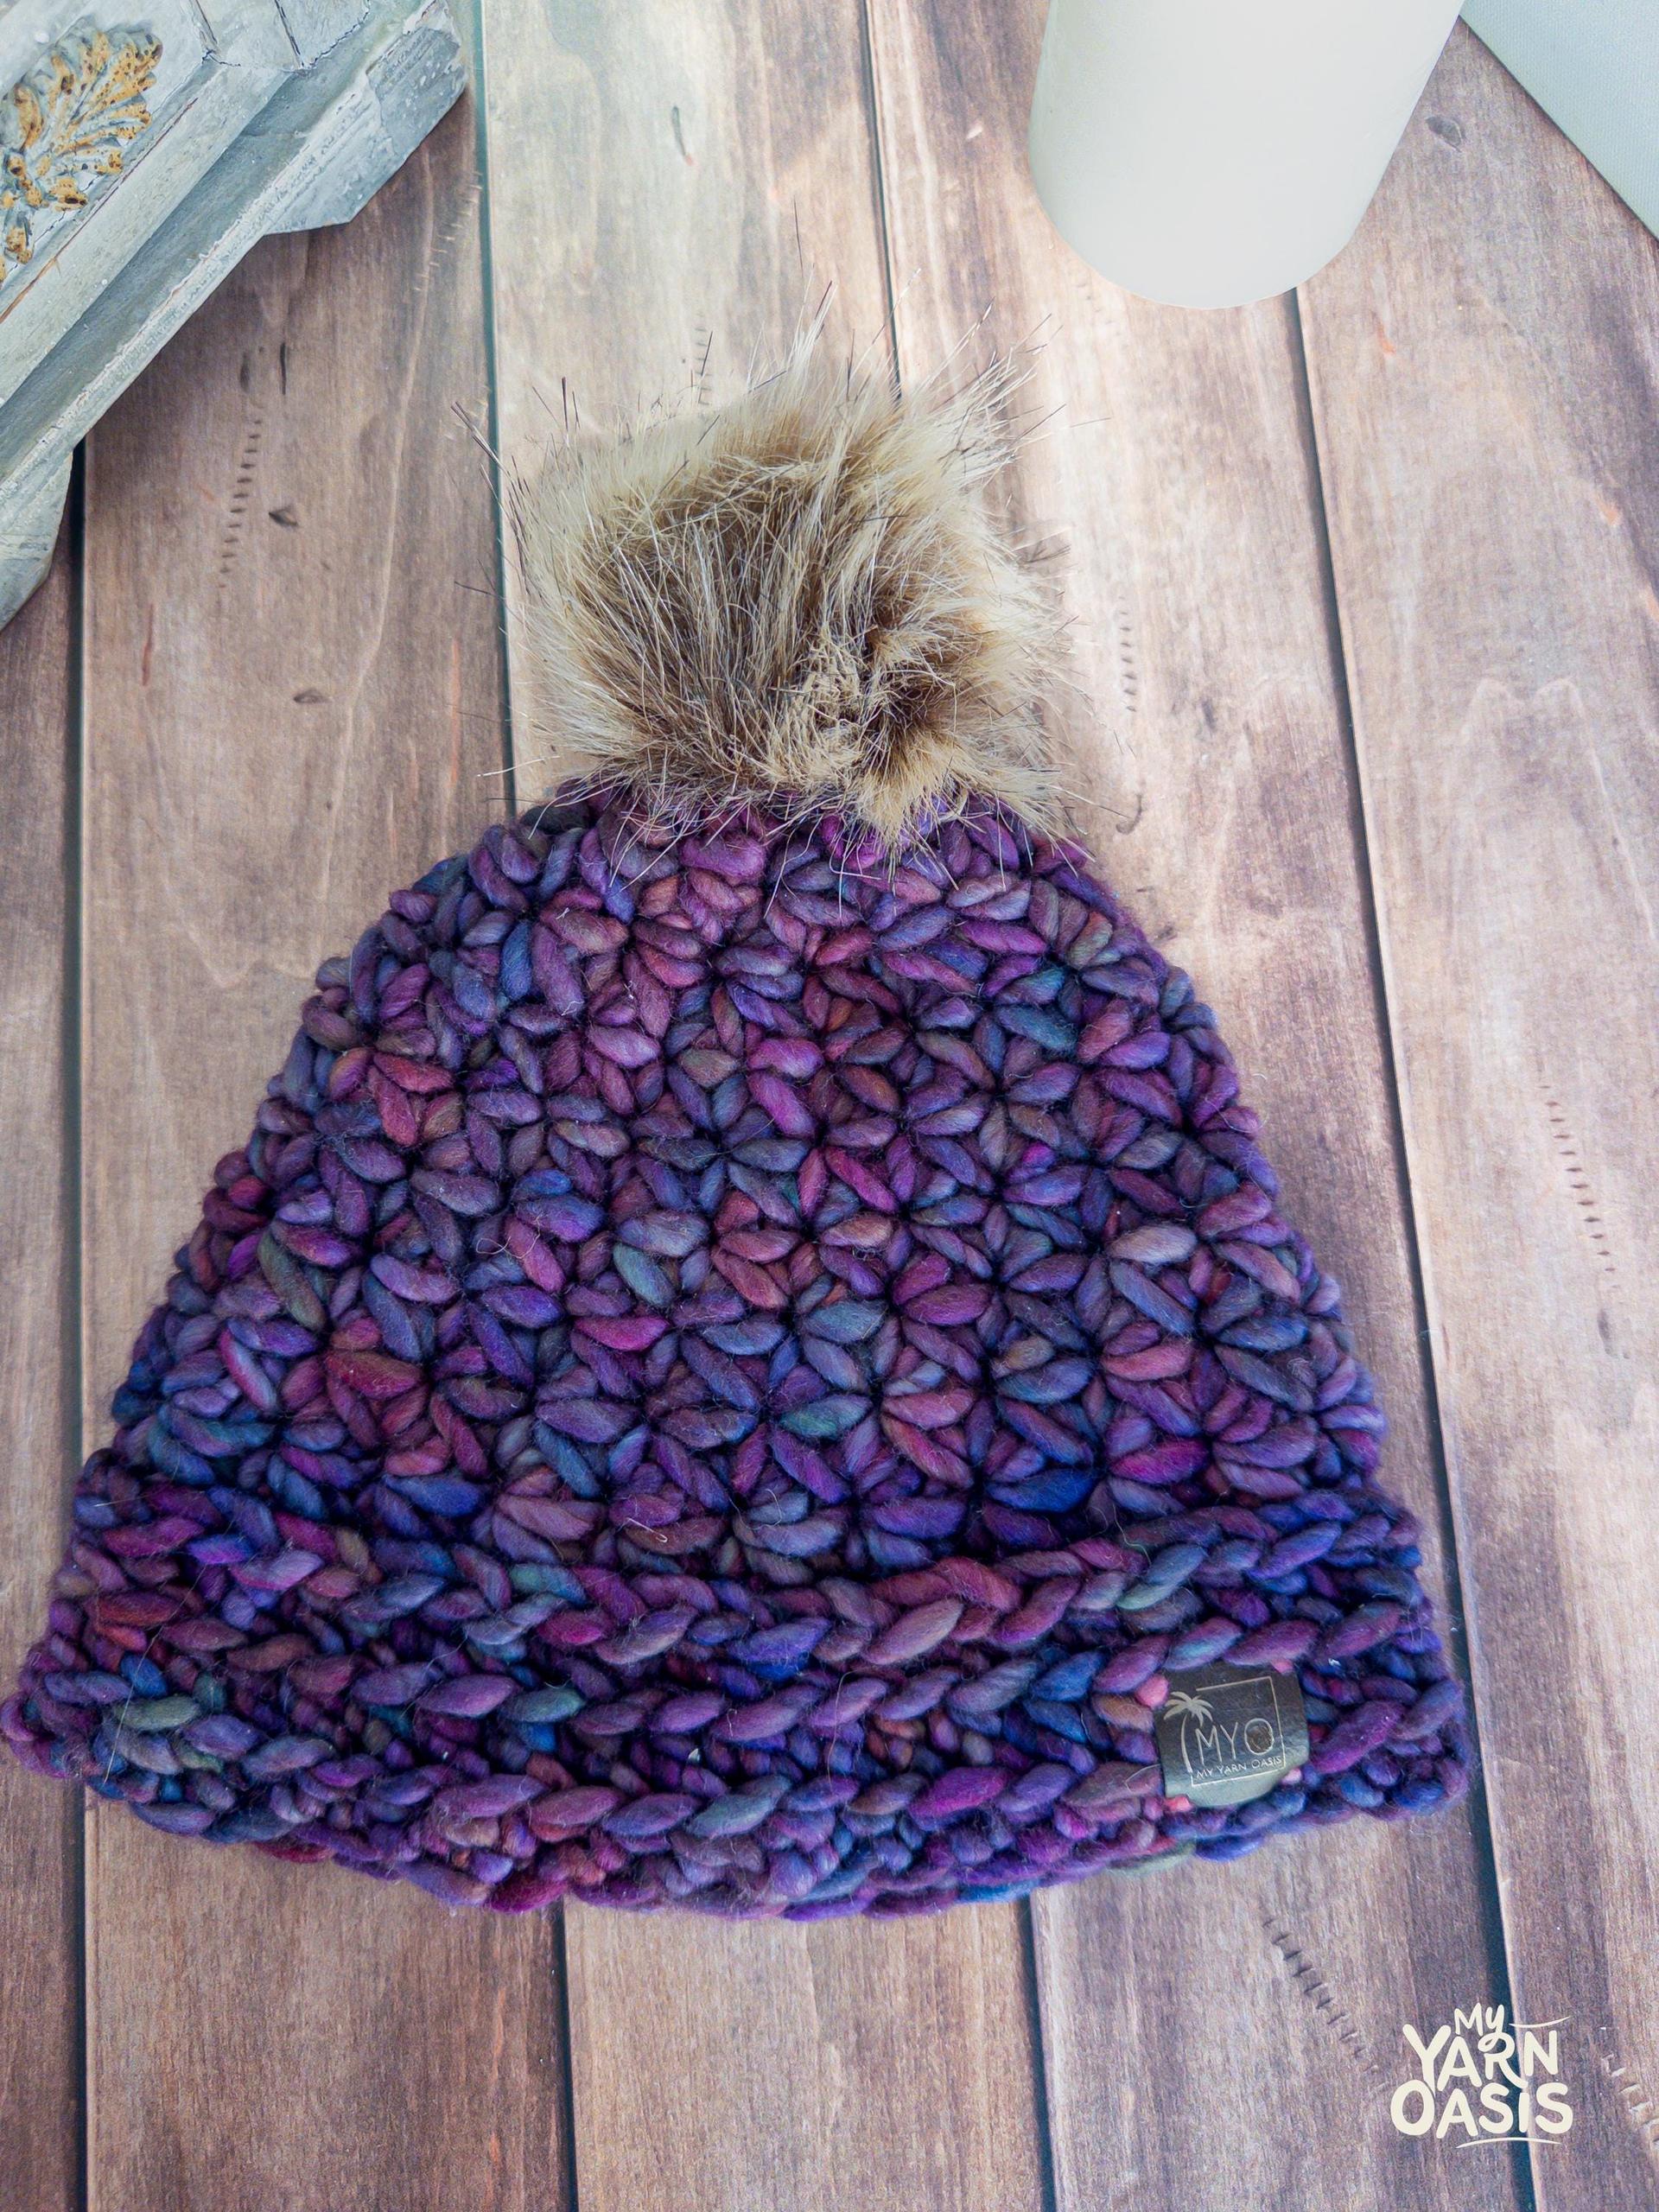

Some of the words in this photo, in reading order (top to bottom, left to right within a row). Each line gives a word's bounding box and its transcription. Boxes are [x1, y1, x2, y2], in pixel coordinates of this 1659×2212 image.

[1195, 1717, 1274, 1767] MYO
[1196, 1768, 1213, 1780] MY
[1217, 1762, 1247, 1775] YARN
[1251, 1754, 1282, 1769] OASIS
